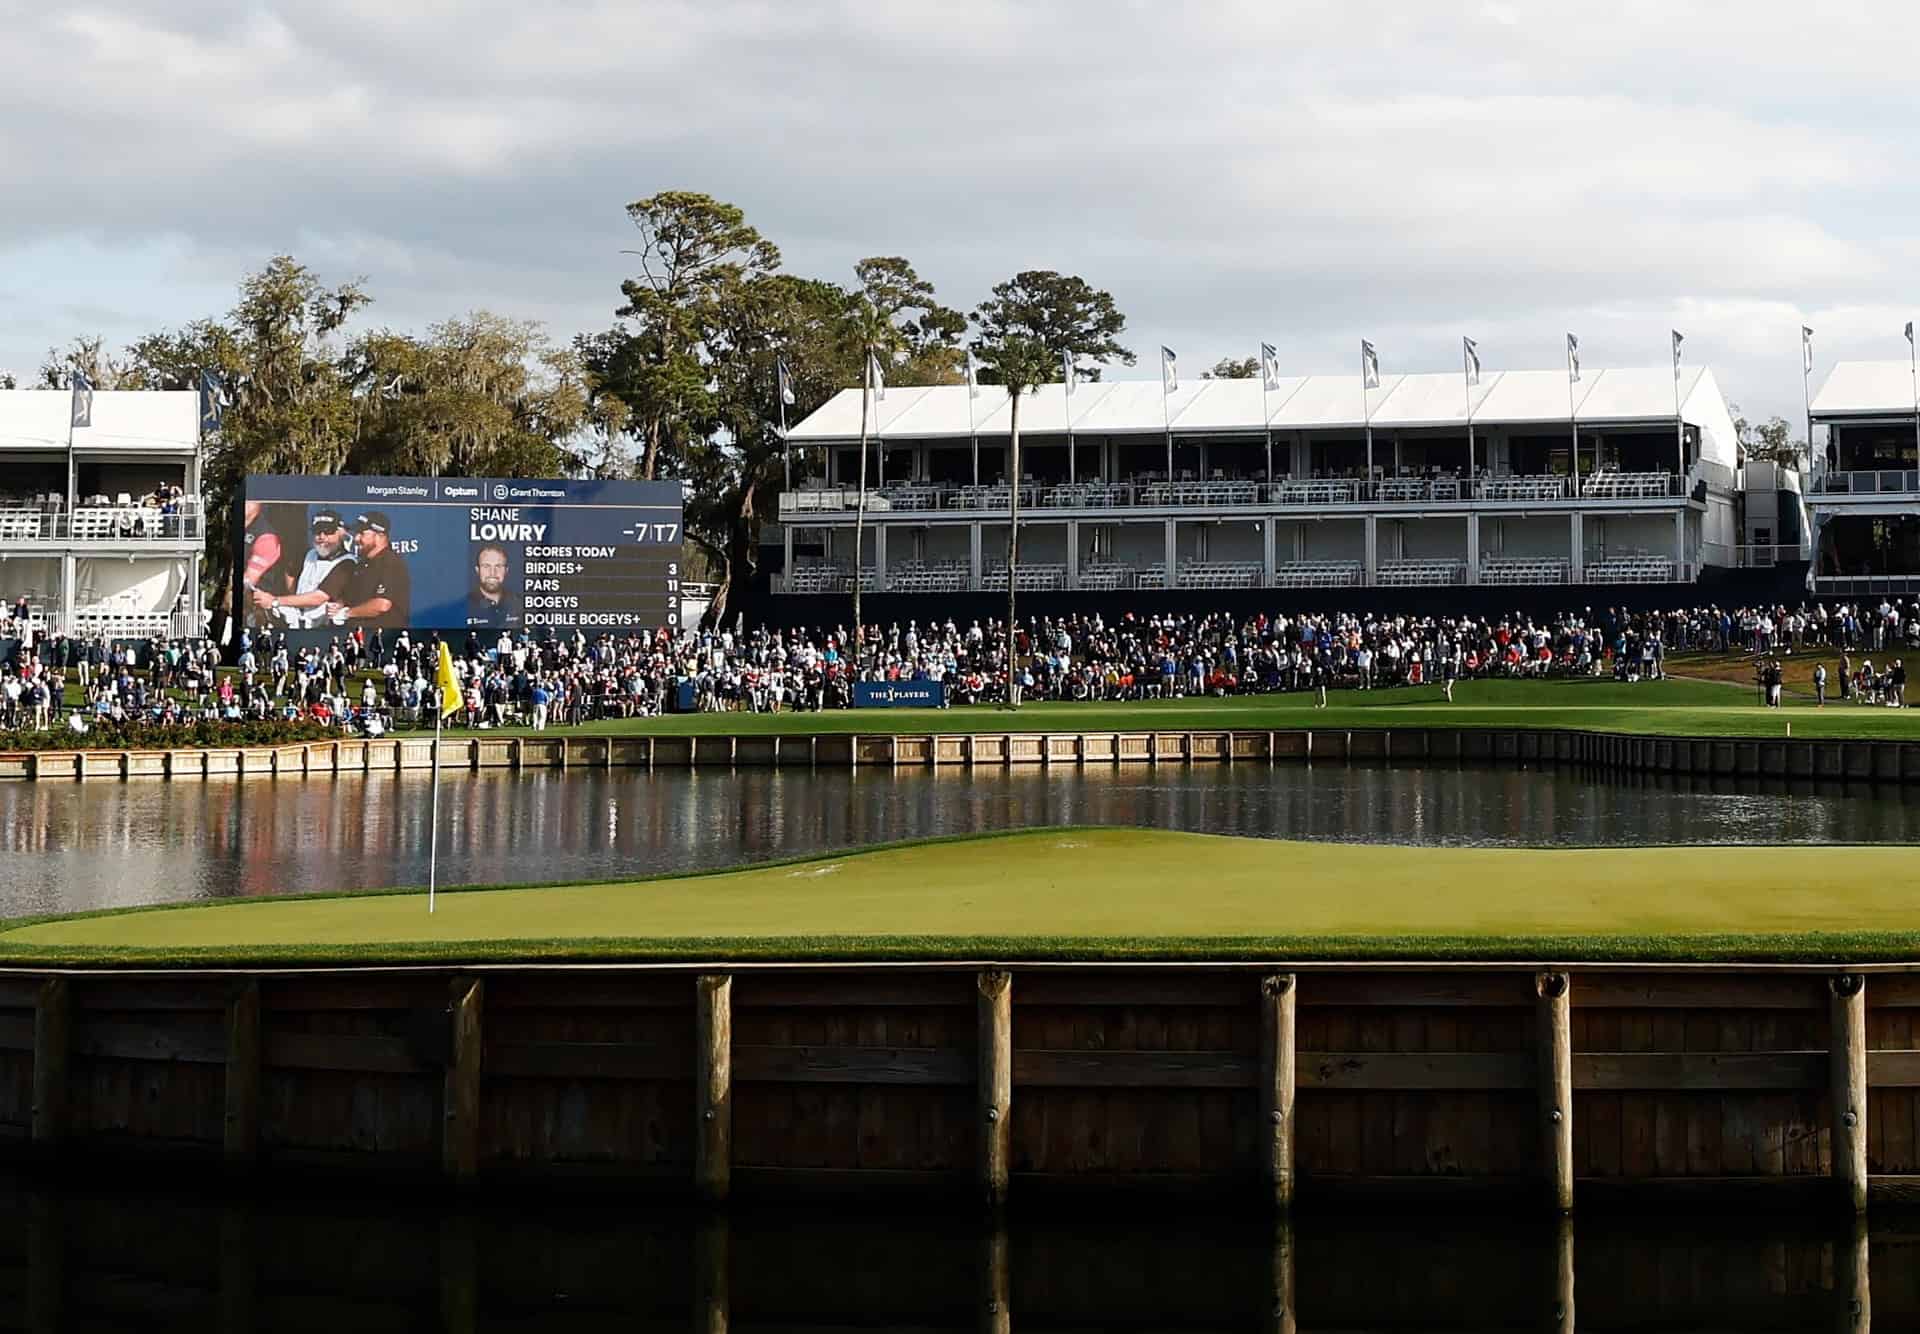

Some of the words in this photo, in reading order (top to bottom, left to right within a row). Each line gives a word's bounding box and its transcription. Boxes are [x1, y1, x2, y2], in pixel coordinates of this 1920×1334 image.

[367, 485, 398, 496] Morgan
[398, 486, 428, 496] Stanley
[444, 486, 478, 497] Optum
[470, 508, 520, 521] SHANE
[470, 524, 547, 541] LOWRY
[525, 546, 572, 557] SCORES
[575, 546, 616, 558] TODAY
[525, 563, 584, 574] BIRDIES+
[669, 564, 677, 575] 3
[525, 580, 560, 591] PARS
[667, 580, 678, 592] 11
[525, 596, 578, 608] BOGEYS
[668, 597, 677, 608] 2
[525, 613, 576, 624] DOUBLE
[580, 613, 640, 625] BOGEYS+
[668, 614, 677, 625] 0
[870, 691, 887, 699] THE
